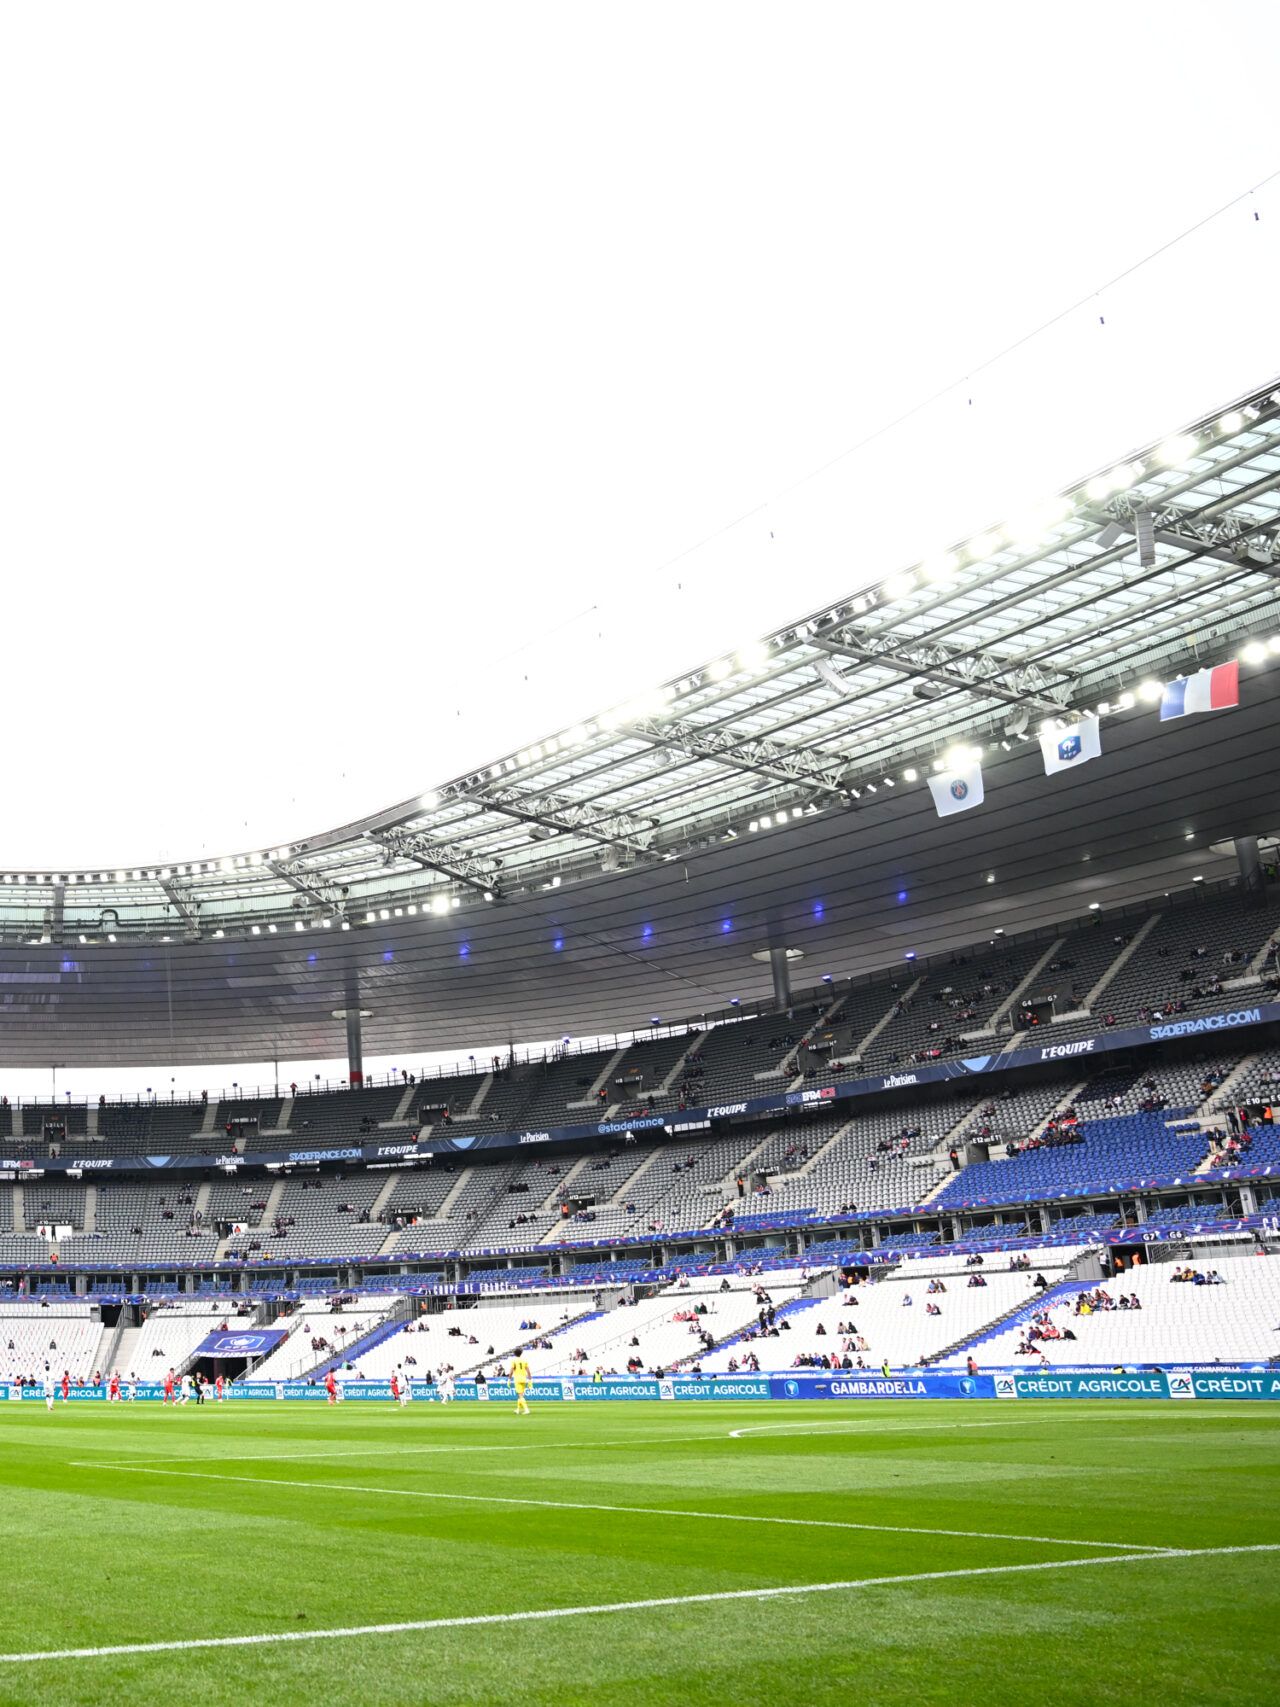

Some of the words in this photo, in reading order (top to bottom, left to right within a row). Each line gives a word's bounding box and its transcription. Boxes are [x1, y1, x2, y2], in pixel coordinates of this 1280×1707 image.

[1150, 1008, 1260, 1039] STADEFRANCE.COM
[884, 1079, 891, 1087] Le
[890, 1074, 916, 1087] Parisien
[598, 1117, 664, 1133] @stadefrance
[520, 1134, 526, 1143] Le
[526, 1132, 550, 1142] Parisien
[222, 1156, 244, 1165] Parisien
[289, 1149, 362, 1161] STADEFRANCE.COM
[433, 1283, 459, 1294] COUPE
[465, 1283, 474, 1293] DE
[480, 1281, 509, 1292] FRANCE
[576, 1385, 607, 1395] CRÉDIT
[610, 1386, 656, 1395] AGRICOLE
[675, 1384, 710, 1395] CRÉDIT
[714, 1385, 767, 1394] AGRICOLE
[831, 1381, 927, 1394] GAMBARDELLA
[1018, 1378, 1072, 1392] CRÉDIT
[1078, 1380, 1162, 1392] AGRICOLE
[1196, 1377, 1263, 1392] CRÉDIT
[284, 1387, 303, 1396] CRÉDIT
[344, 1388, 366, 1396] CRÉDIT
[412, 1387, 437, 1396] CRÉDIT
[489, 1386, 516, 1396] CRÉDIT
